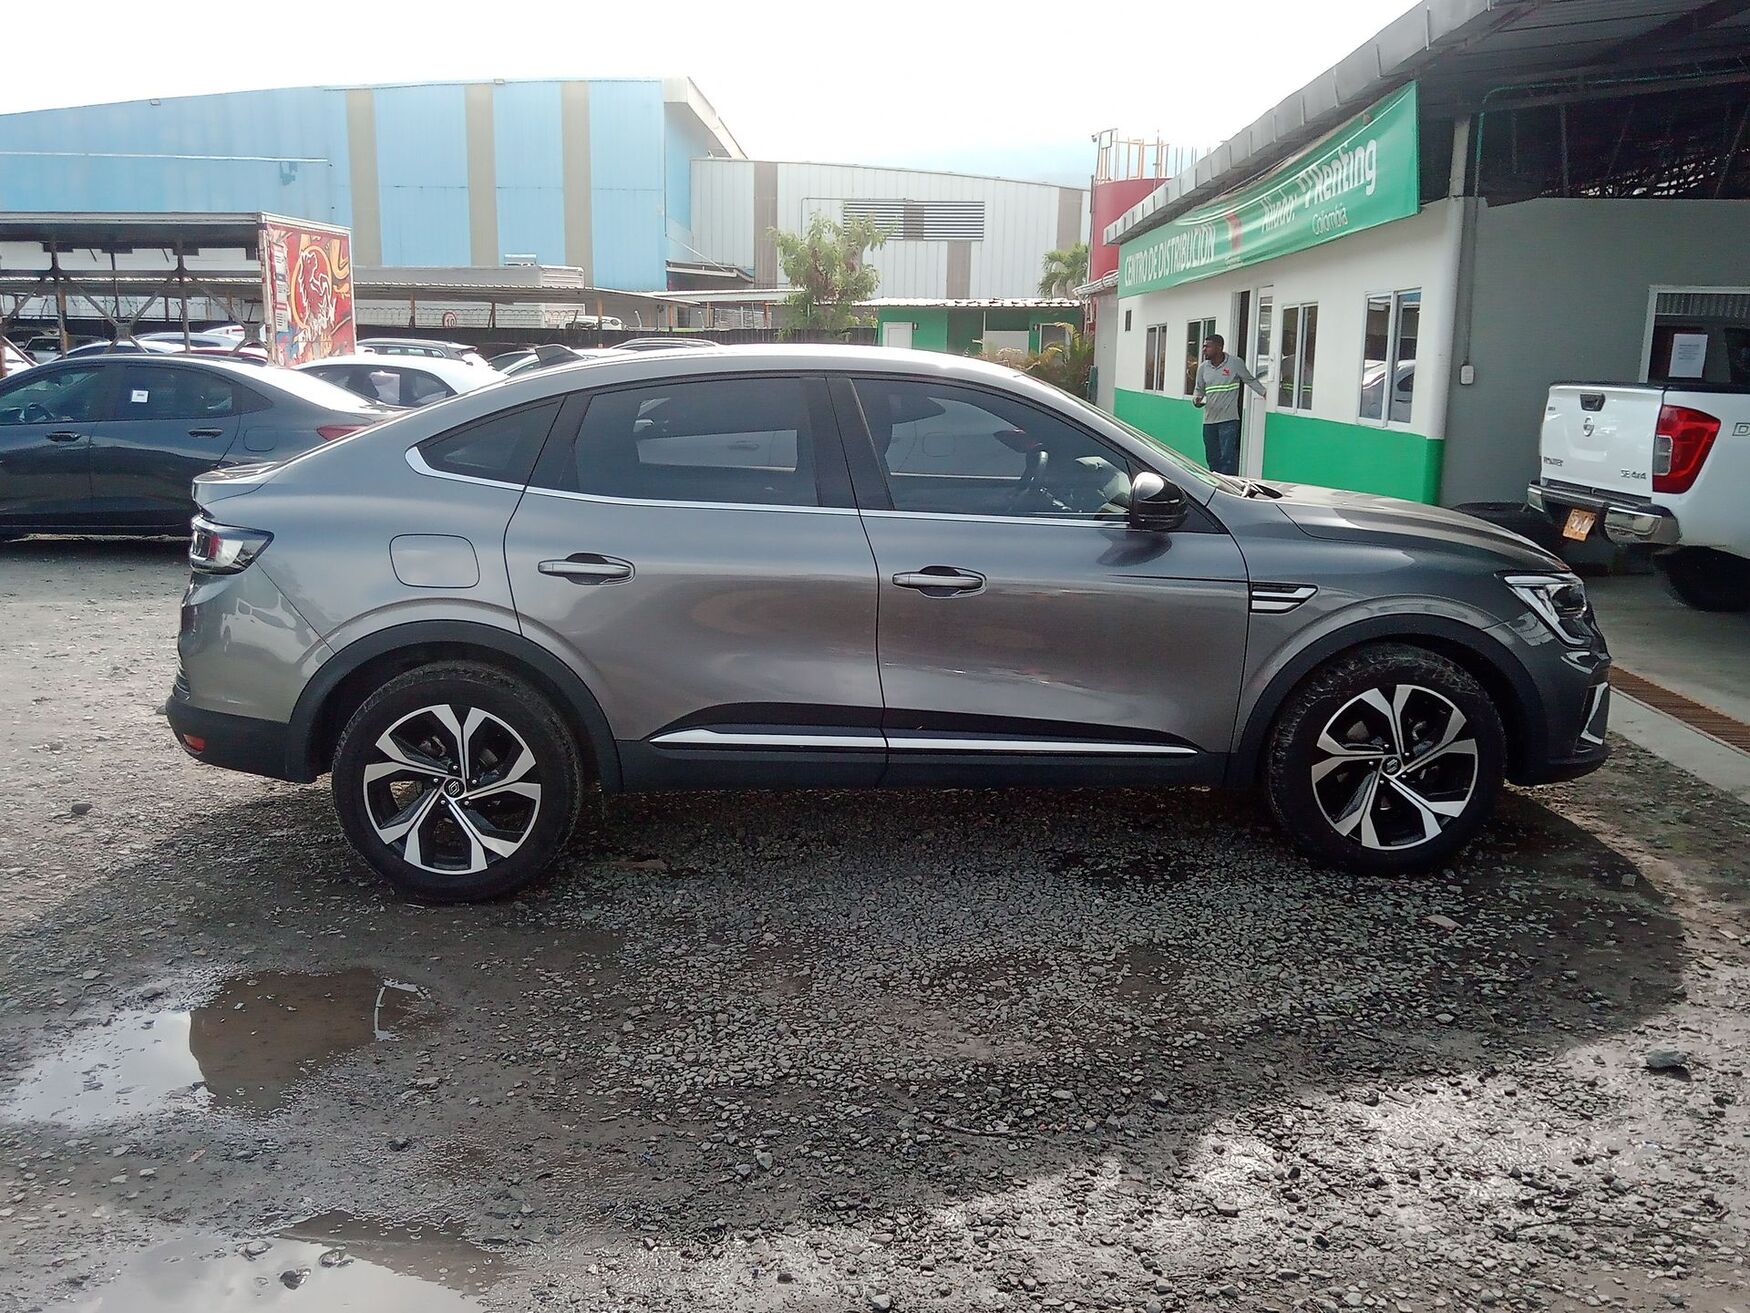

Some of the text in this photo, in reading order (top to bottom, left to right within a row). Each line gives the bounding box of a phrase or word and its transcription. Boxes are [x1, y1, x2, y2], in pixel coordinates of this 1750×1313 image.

[1309, 139, 1377, 205] Renting
[1312, 203, 1348, 235] Colombia
[1124, 249, 1147, 287] CENTRO
[1147, 245, 1159, 281] DE
